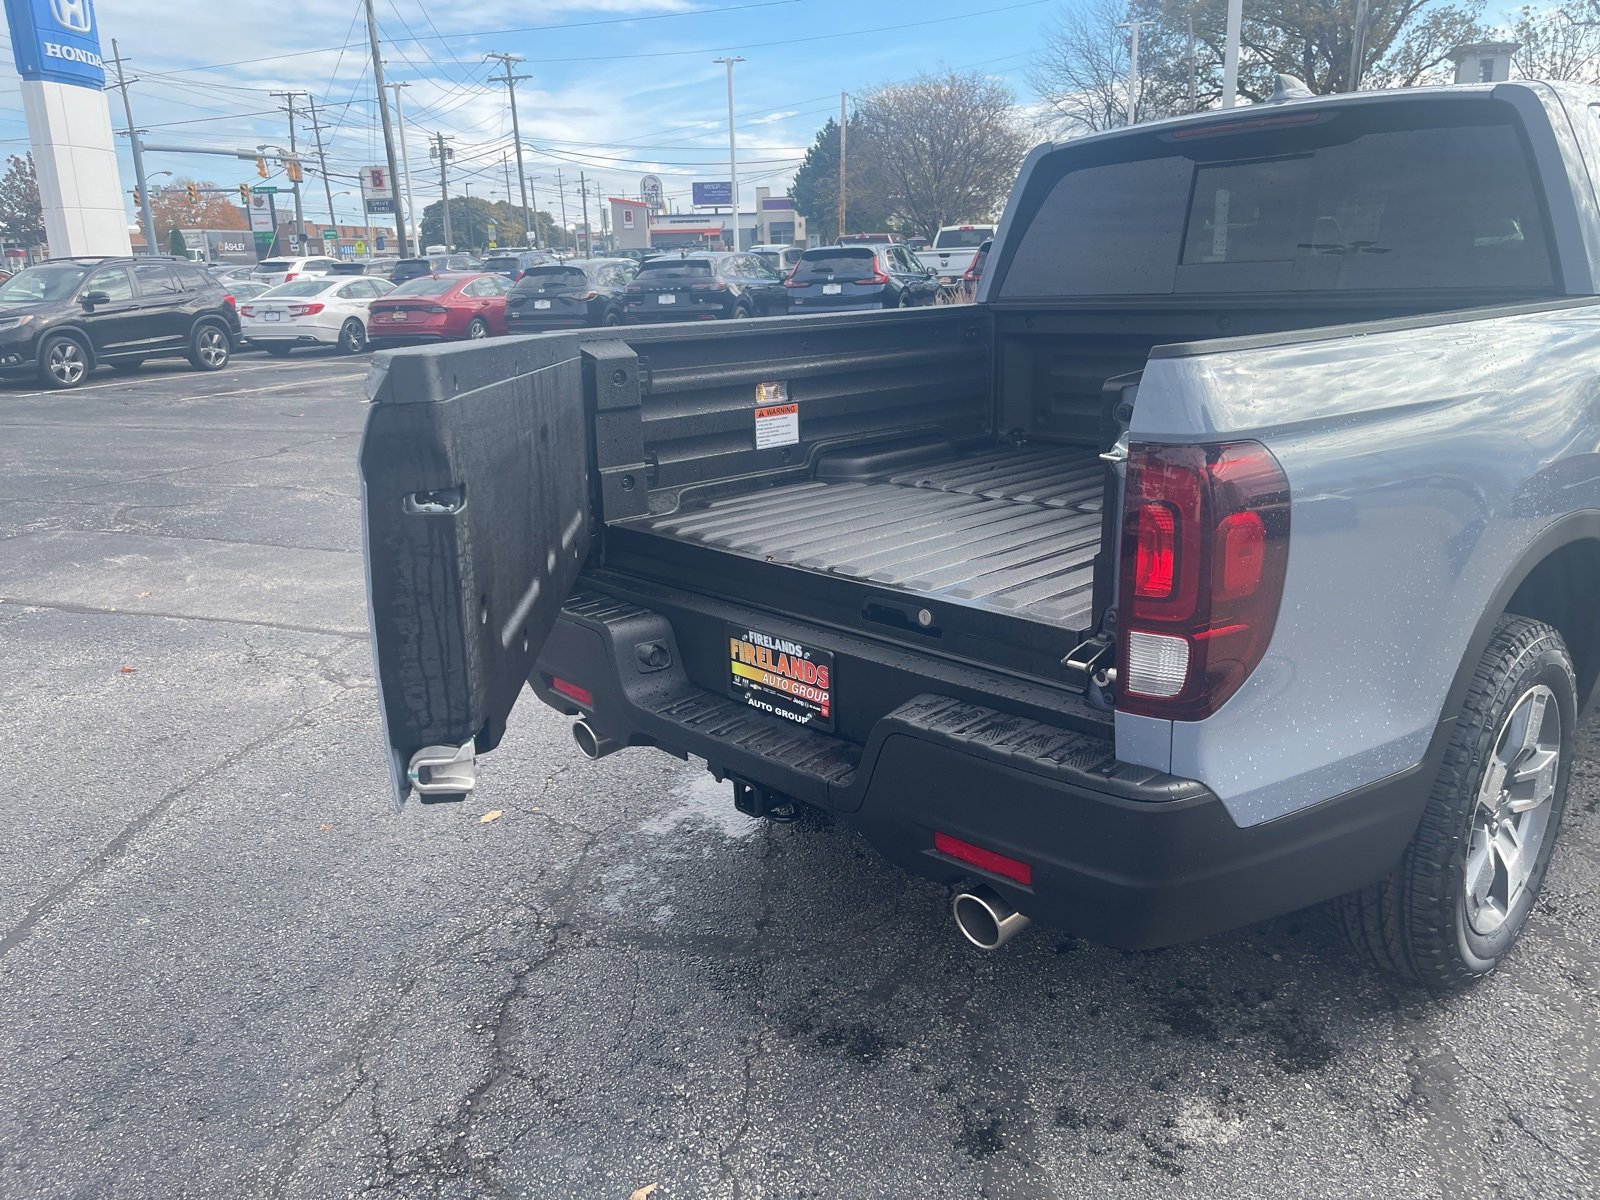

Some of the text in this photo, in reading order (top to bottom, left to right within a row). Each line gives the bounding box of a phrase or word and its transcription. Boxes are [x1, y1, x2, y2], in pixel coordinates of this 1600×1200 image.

[43, 41, 104, 69] HONDA
[224, 241, 246, 250] ASHLEY
[766, 404, 795, 416] WARNING
[748, 630, 803, 657] FIRELANDS
[729, 637, 830, 690] FIRELANDS
[762, 673, 788, 690] AUTO
[791, 683, 829, 703] GROUP
[747, 697, 773, 712] AUTO
[774, 707, 808, 725] GROUP
[792, 697, 805, 707] Jeep
